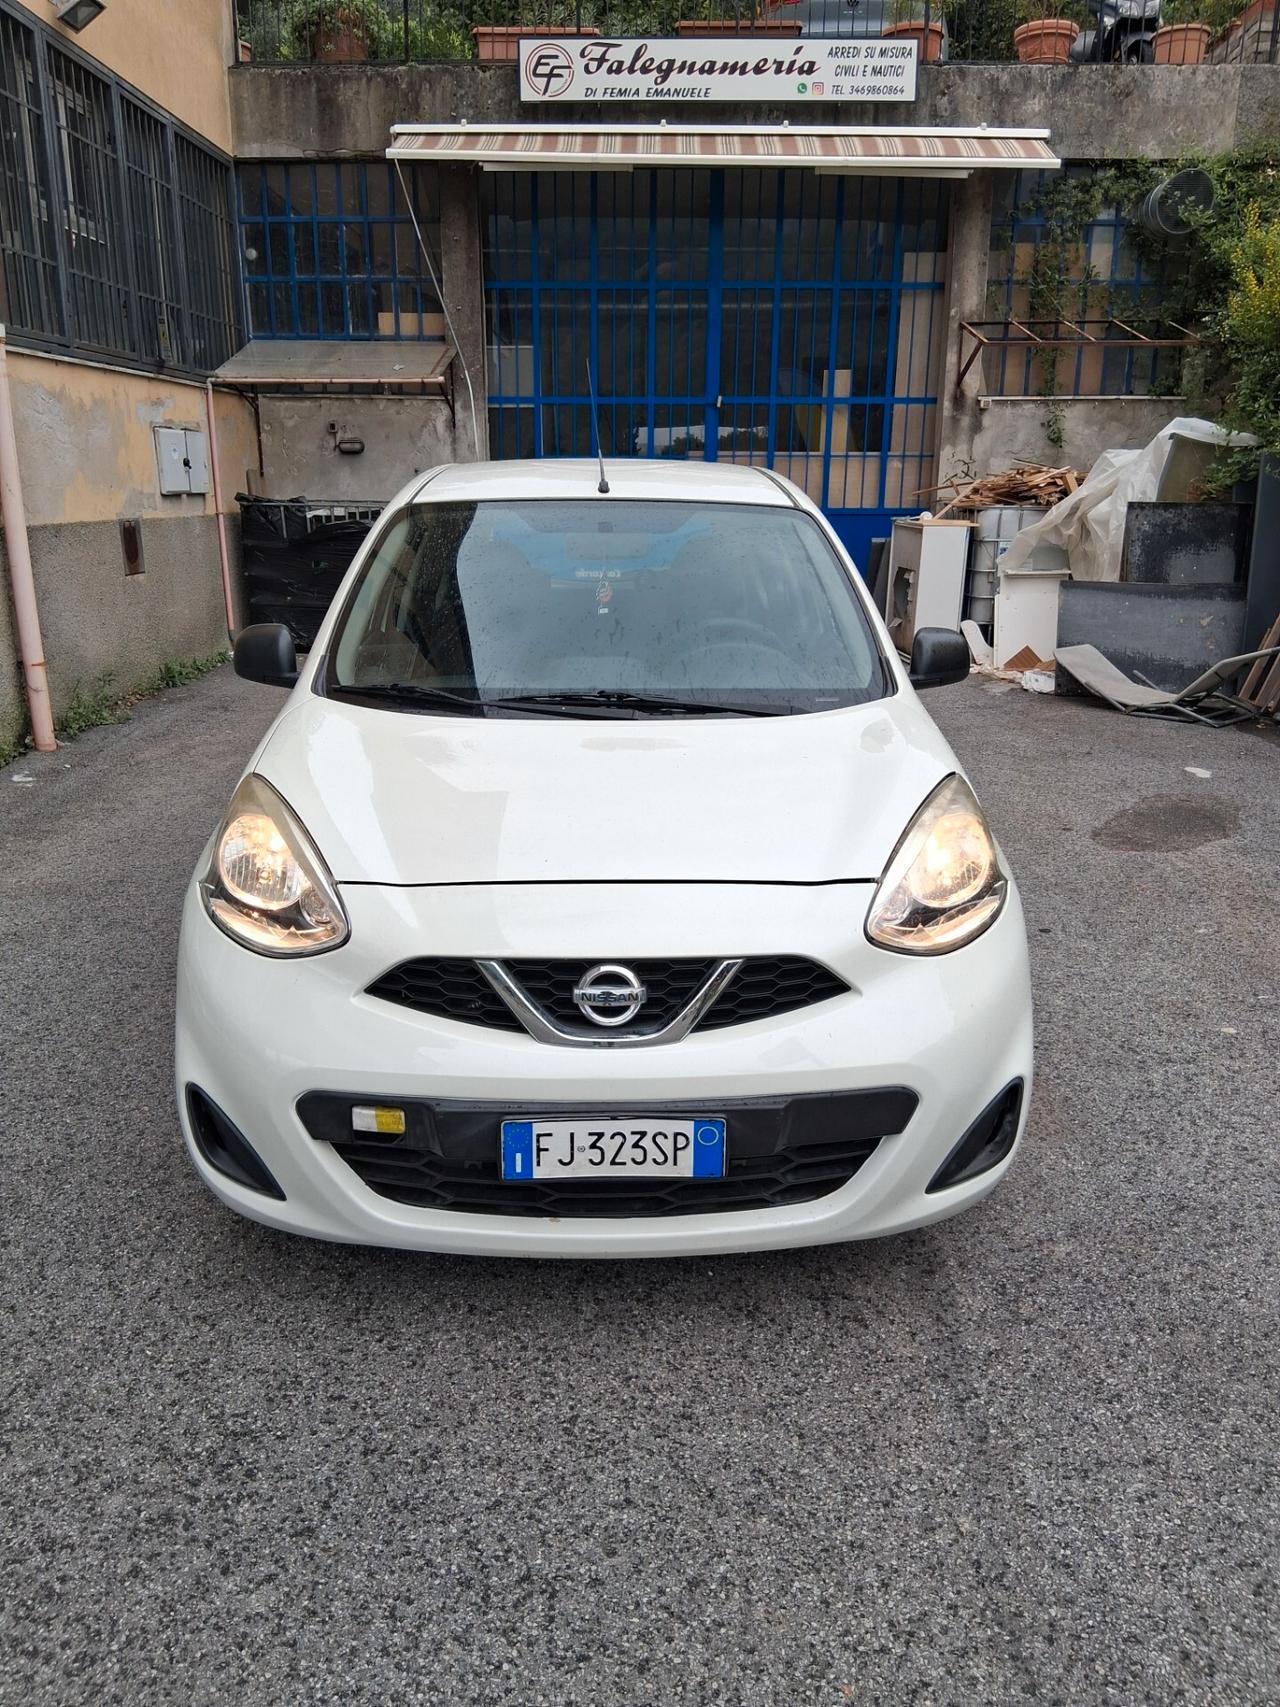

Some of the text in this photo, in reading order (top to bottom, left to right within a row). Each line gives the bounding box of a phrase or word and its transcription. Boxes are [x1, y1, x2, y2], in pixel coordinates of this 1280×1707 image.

[827, 46, 913, 59] ARREDI SU MISURA
[579, 42, 821, 86] Falegnameria
[834, 64, 905, 78] CIVILI E NAUTICI
[584, 87, 712, 98] DI FEMIA EMANUELE
[849, 84, 905, 96] 3469860864
[580, 992, 639, 1002] NISSAN
